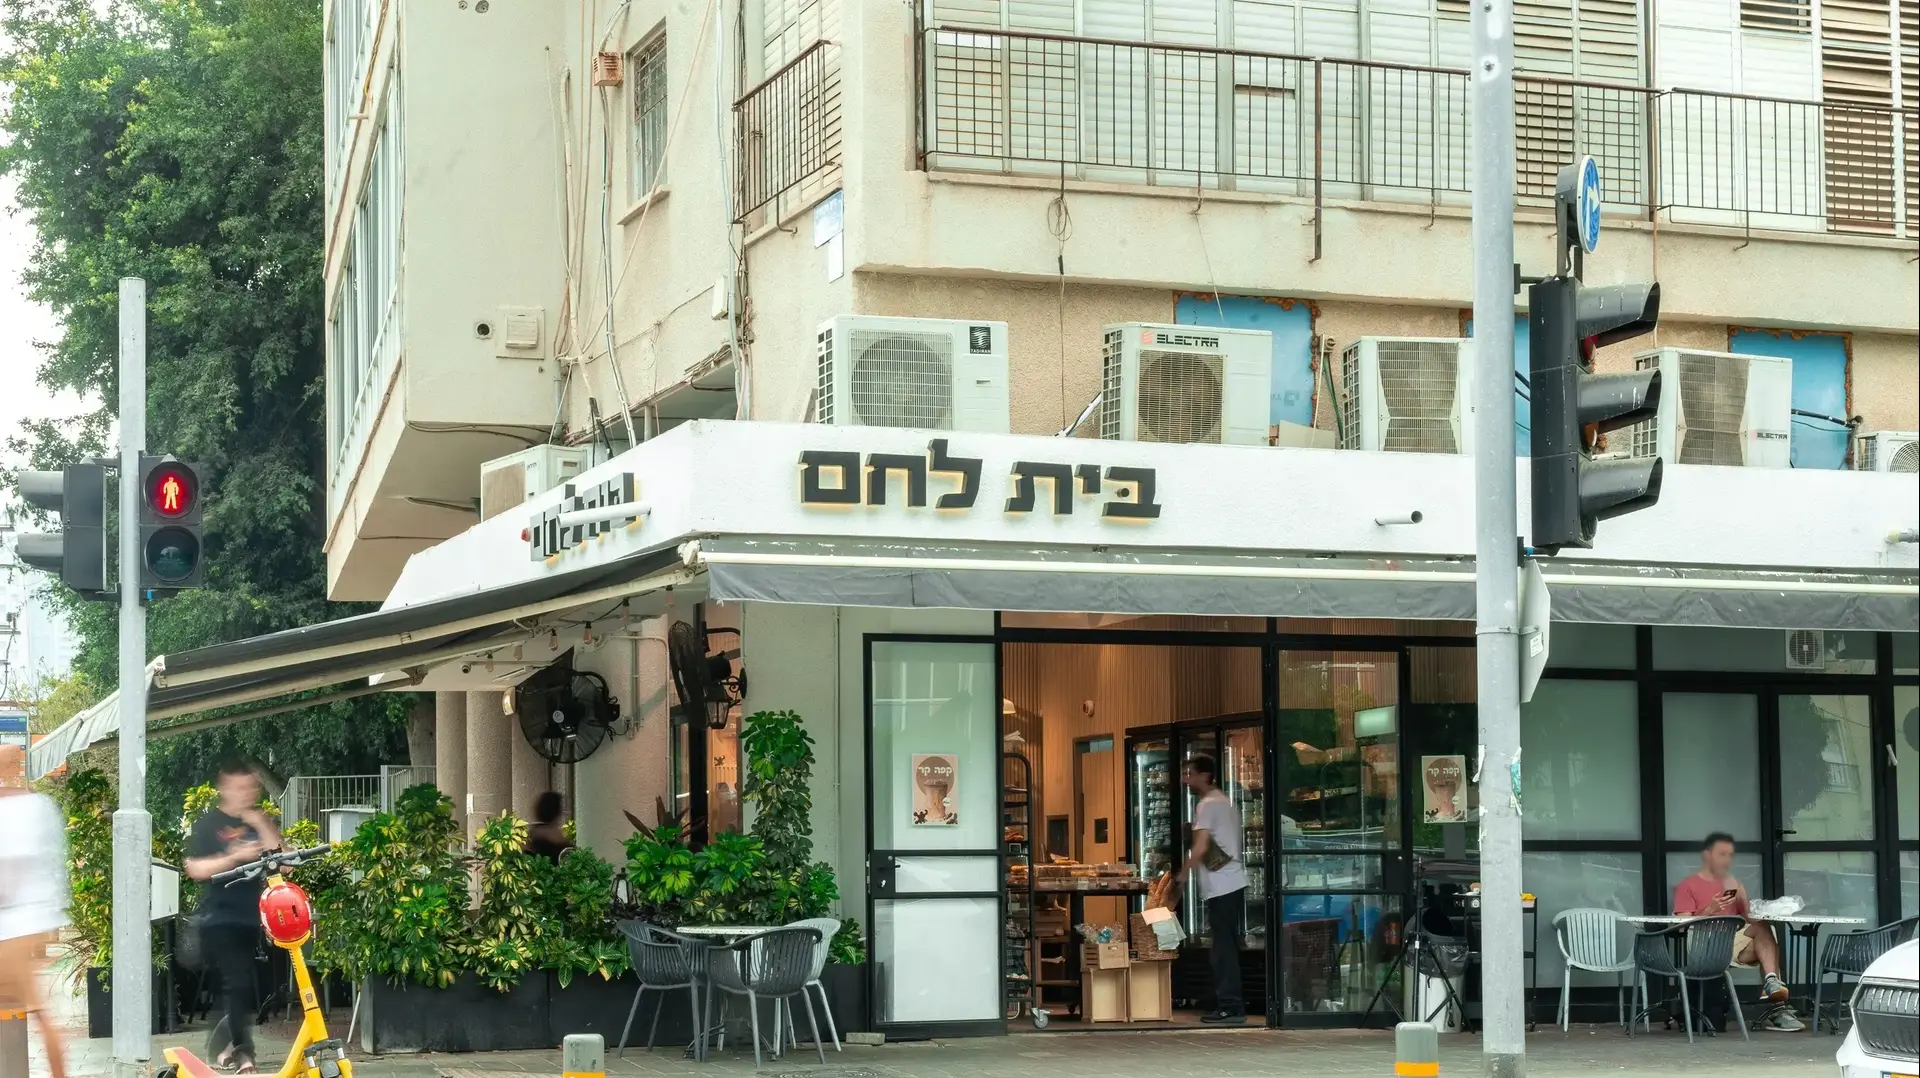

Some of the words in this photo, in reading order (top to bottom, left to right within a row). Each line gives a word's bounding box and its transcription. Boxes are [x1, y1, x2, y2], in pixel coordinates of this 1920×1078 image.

[1156, 333, 1219, 348] ELECTRA
[798, 438, 983, 508] לחם
[1004, 461, 1161, 519] בית
[918, 766, 931, 776] קר
[934, 766, 953, 776] קפה
[1428, 767, 1440, 777] קר
[1442, 767, 1460, 777] קפה
